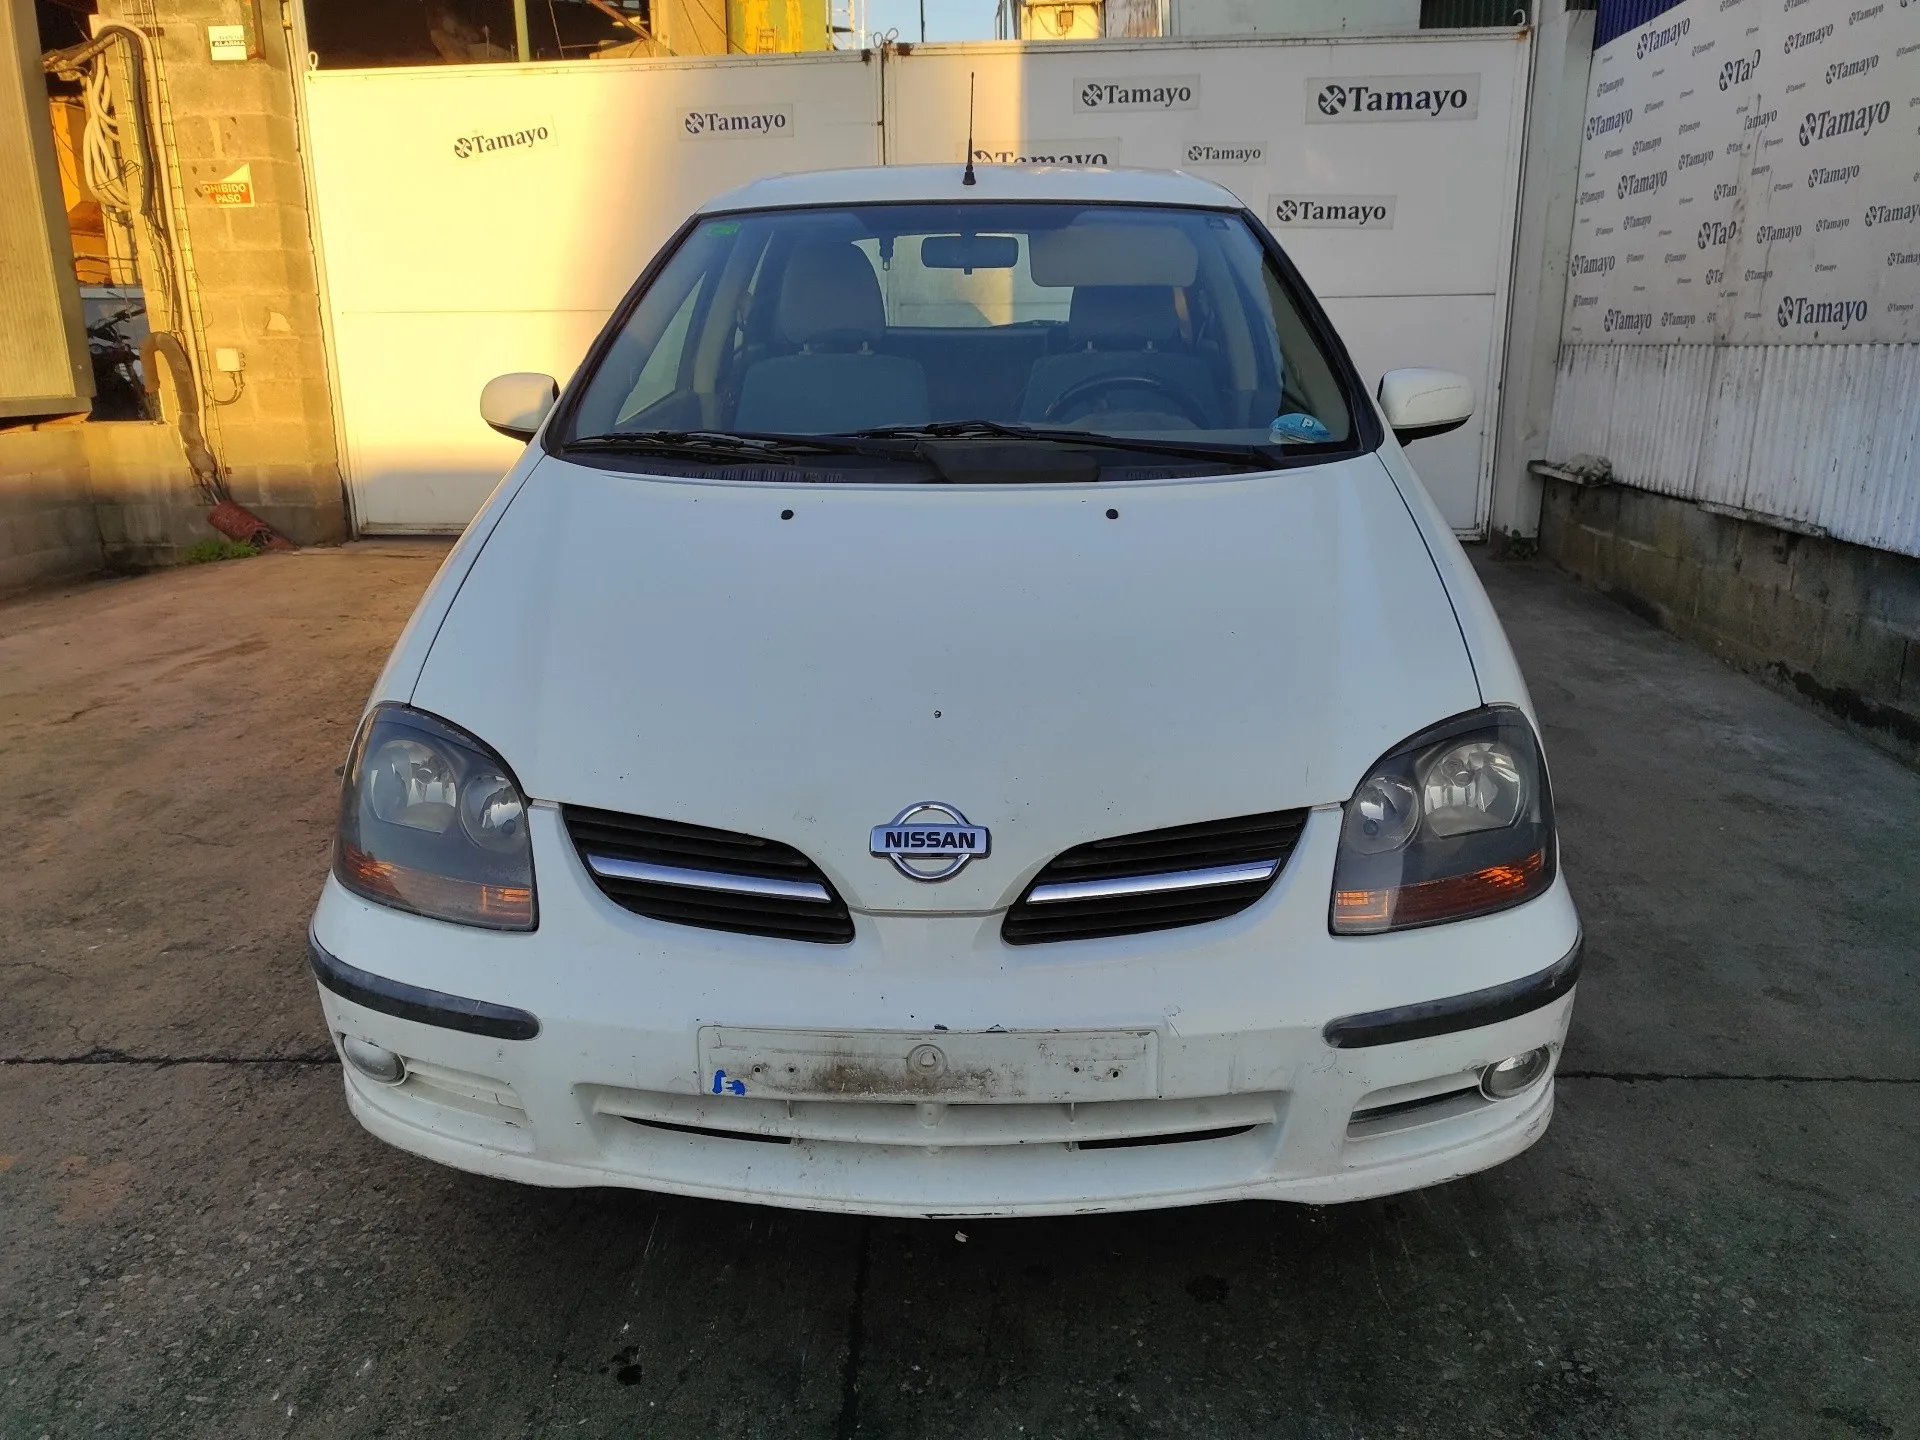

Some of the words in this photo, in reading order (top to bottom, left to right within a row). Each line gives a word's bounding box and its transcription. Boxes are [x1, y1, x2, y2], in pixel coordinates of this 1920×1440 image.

[1855, 4, 1884, 22] Tamayo
[1648, 17, 1690, 53] Tamayo
[1795, 23, 1834, 50] Tamayo
[1837, 54, 1879, 80] Tamayo
[1103, 84, 1191, 108] Tamayo
[1348, 86, 1468, 117] Tamayo
[704, 113, 786, 134] Tamayo
[1595, 108, 1633, 136] Tamayo
[1817, 100, 1891, 140] Tamayo
[471, 126, 549, 154] Tamayo
[1203, 146, 1262, 163] Tamayo
[1685, 150, 1714, 168] Tamayo
[1629, 170, 1668, 195] Tamayo
[1819, 164, 1860, 185] Tamayo
[215, 193, 241, 203] PASO
[1299, 201, 1387, 225] Tamayo
[1823, 218, 1850, 231] Tamayo
[1877, 203, 1920, 224] Tamay
[1766, 224, 1802, 243] Tamayo
[1579, 255, 1616, 277] Tamayo
[1614, 310, 1652, 335] Tamayo
[1668, 312, 1696, 328] Tamayo
[1795, 297, 1868, 330] Tamayo
[884, 831, 976, 849] NISSAN
